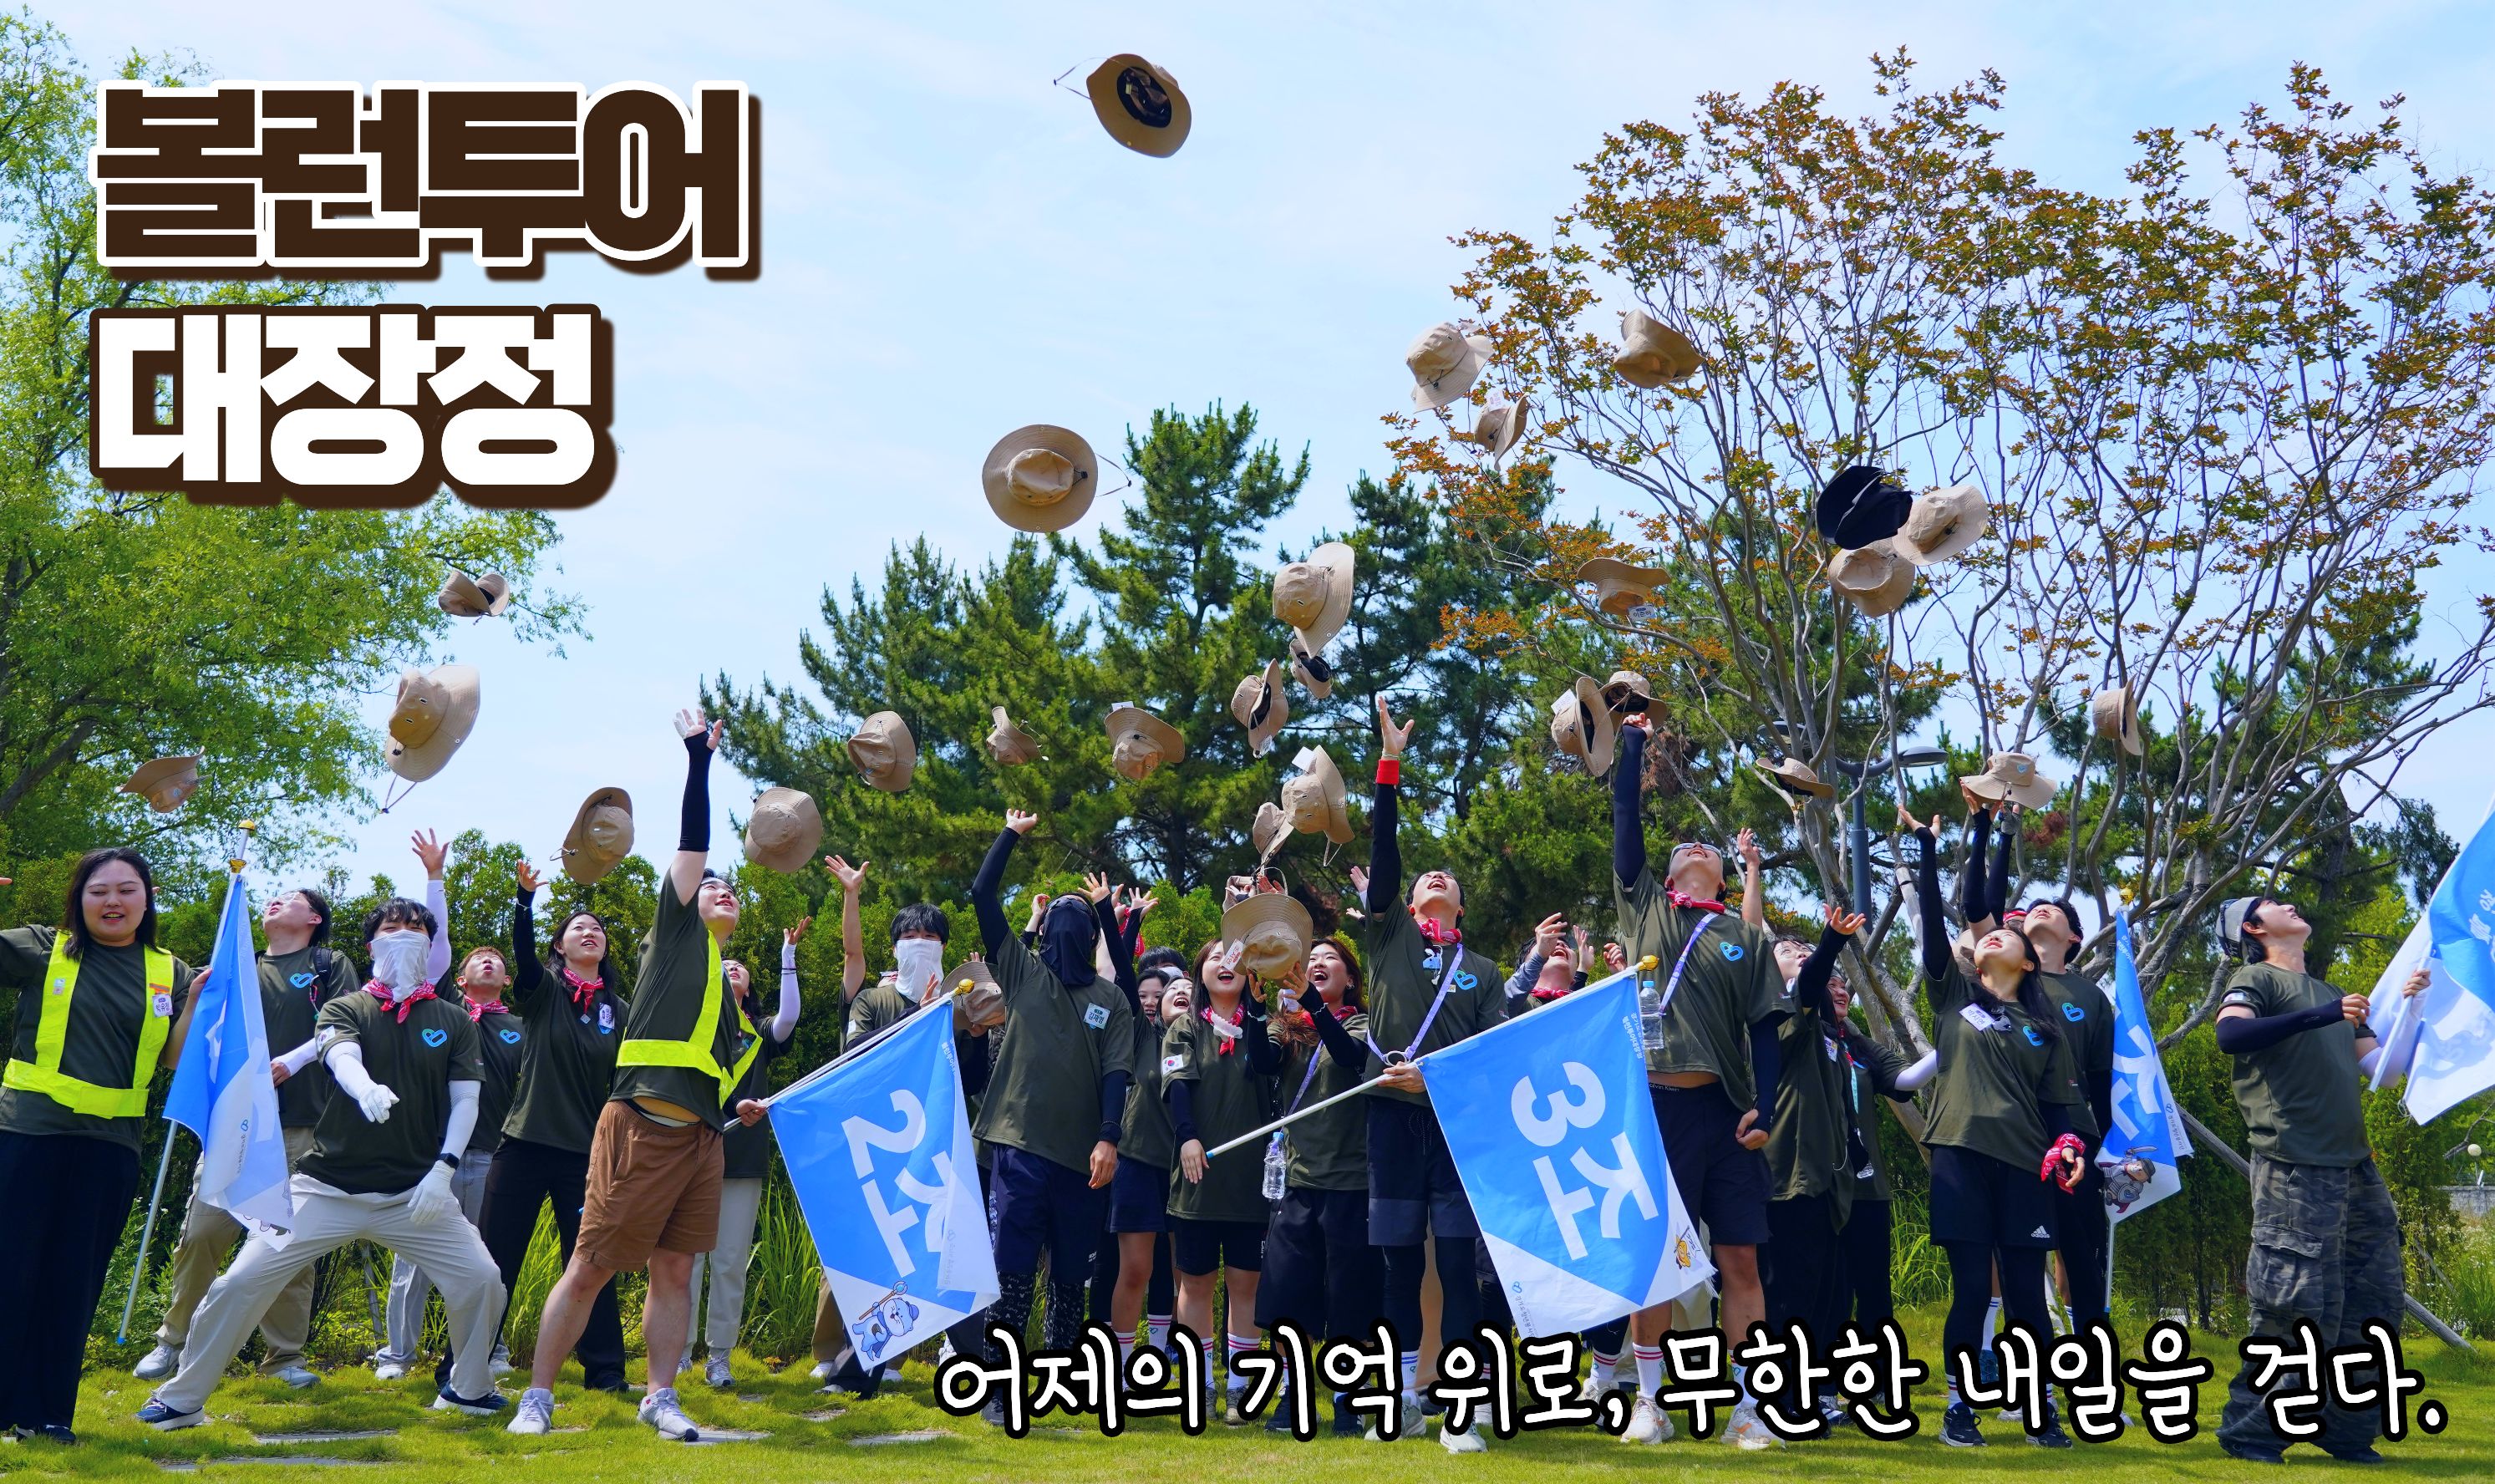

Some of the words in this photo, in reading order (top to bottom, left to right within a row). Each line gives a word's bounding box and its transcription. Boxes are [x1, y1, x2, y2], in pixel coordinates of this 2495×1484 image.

[1089, 1012, 1105, 1024] 김재영
[841, 1089, 954, 1278] 2조
[1511, 1061, 1659, 1261] 3조
